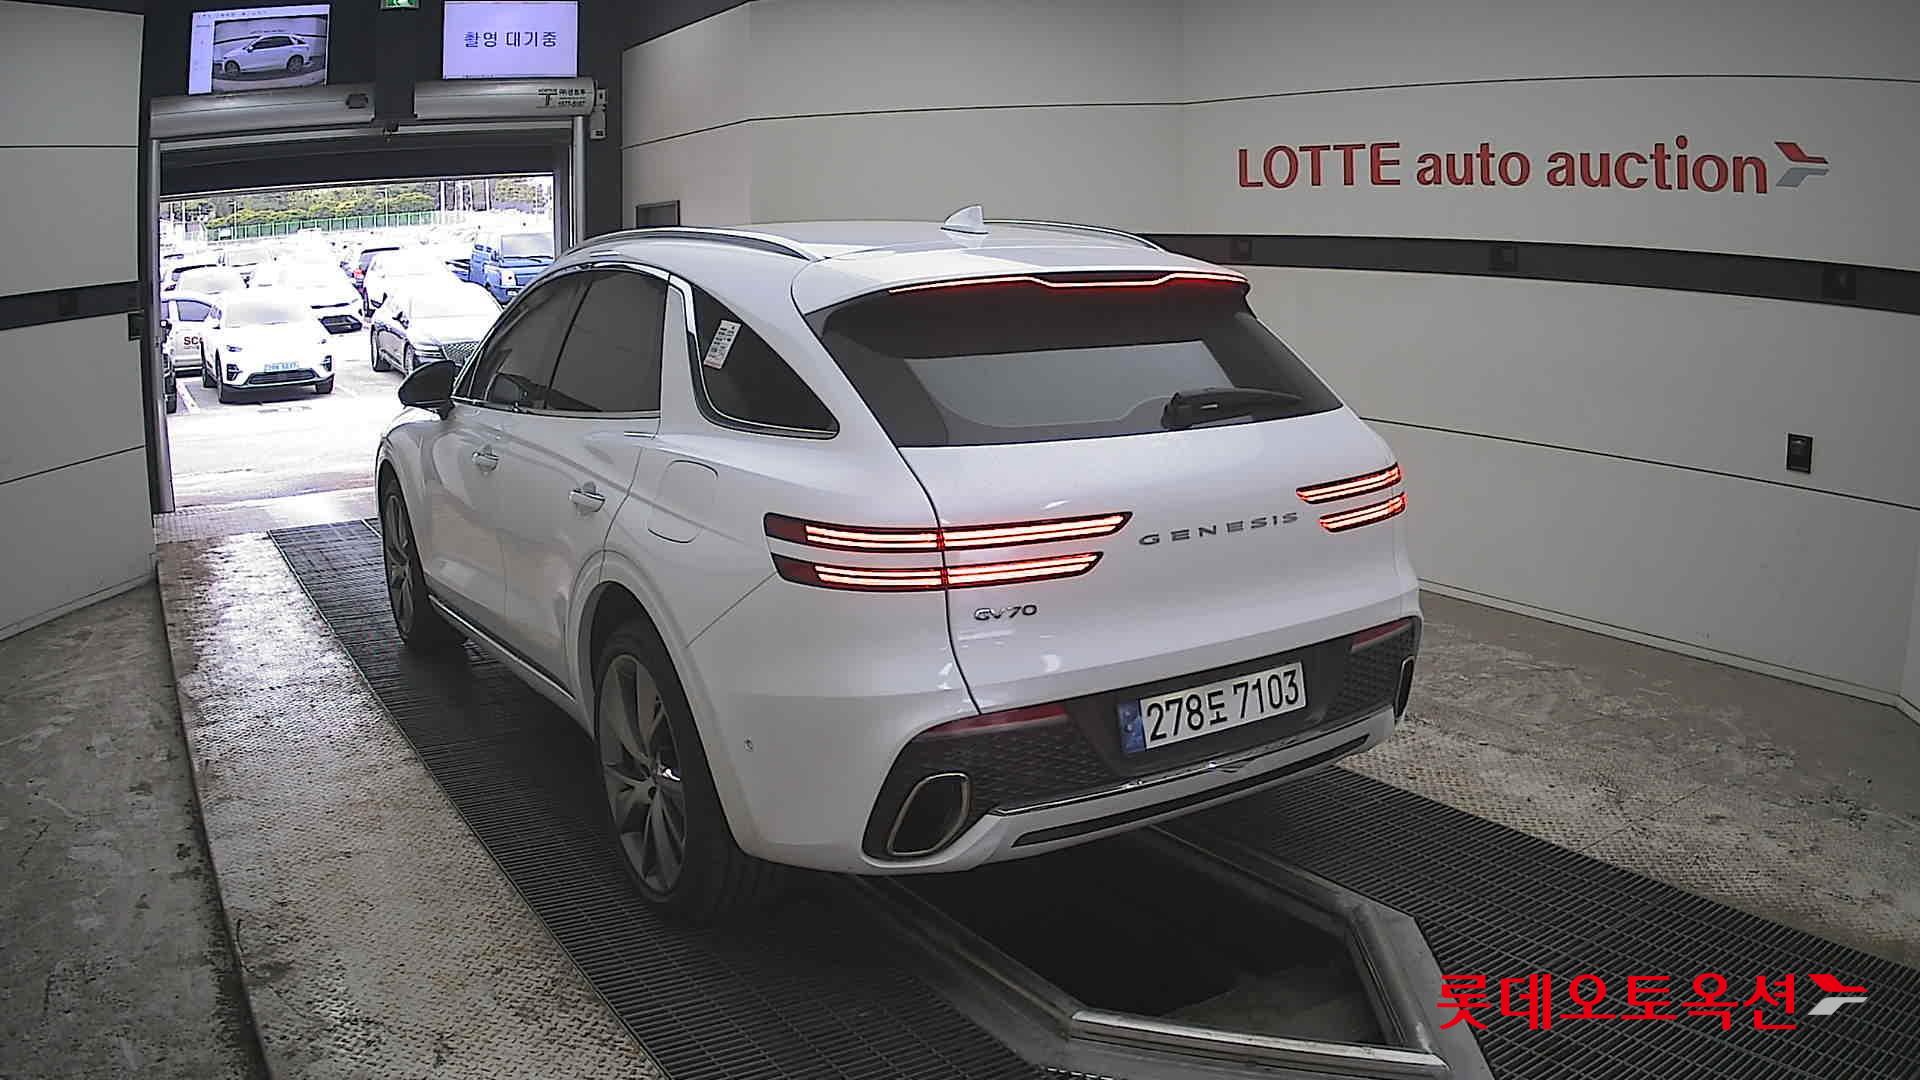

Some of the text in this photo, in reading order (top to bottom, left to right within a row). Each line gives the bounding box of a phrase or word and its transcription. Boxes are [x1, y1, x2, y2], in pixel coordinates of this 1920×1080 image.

[464, 31, 557, 48] 촬영 대기중
[1237, 134, 1769, 194] LOTTE auto auction
[1138, 511, 1299, 546] GENESIS
[974, 604, 1037, 621] GV70
[1233, 669, 1300, 720] 7103
